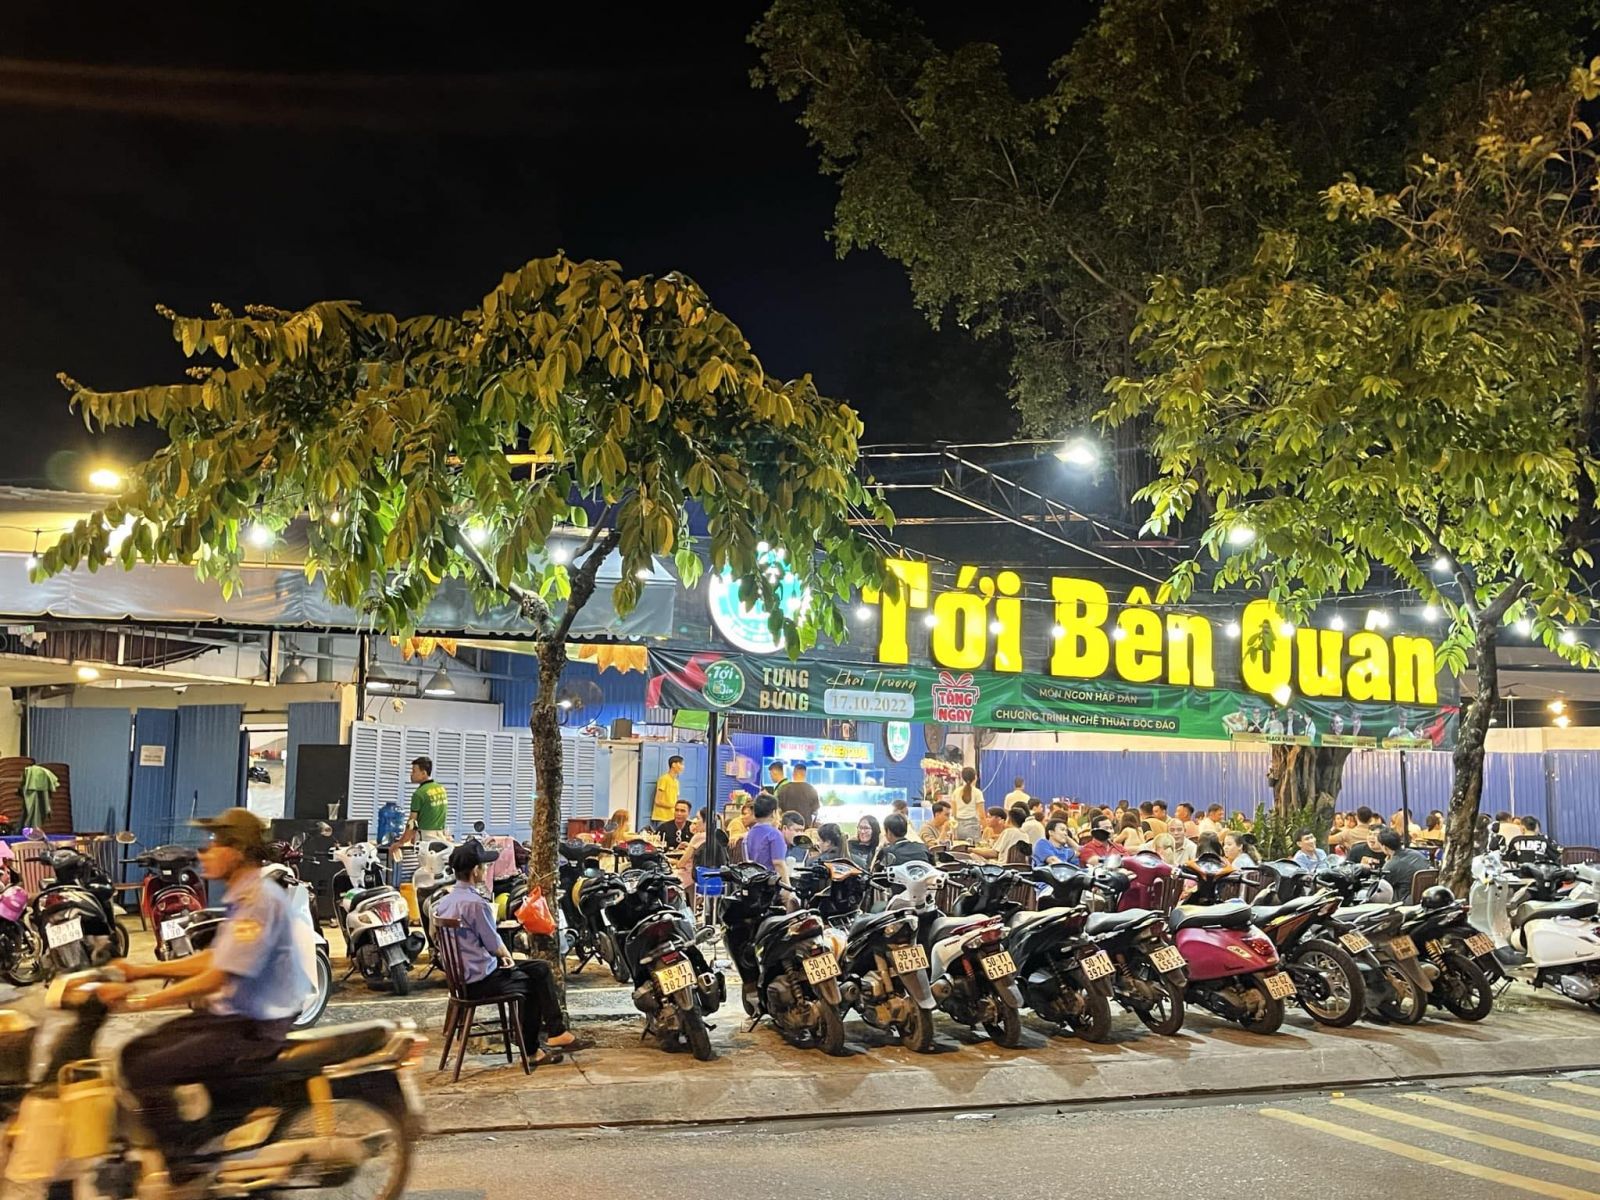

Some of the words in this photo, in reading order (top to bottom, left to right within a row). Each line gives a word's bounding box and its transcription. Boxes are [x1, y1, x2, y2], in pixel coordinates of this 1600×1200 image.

[862, 558, 1023, 673] Tới
[1050, 576, 1215, 688] Bến
[1241, 599, 1438, 706] Quán
[762, 666, 809, 688] TƯNG
[760, 687, 809, 711] BỪNG
[831, 695, 907, 712] 17.10.2022
[1064, 690, 1093, 701] NGON
[938, 708, 973, 722] NGAY
